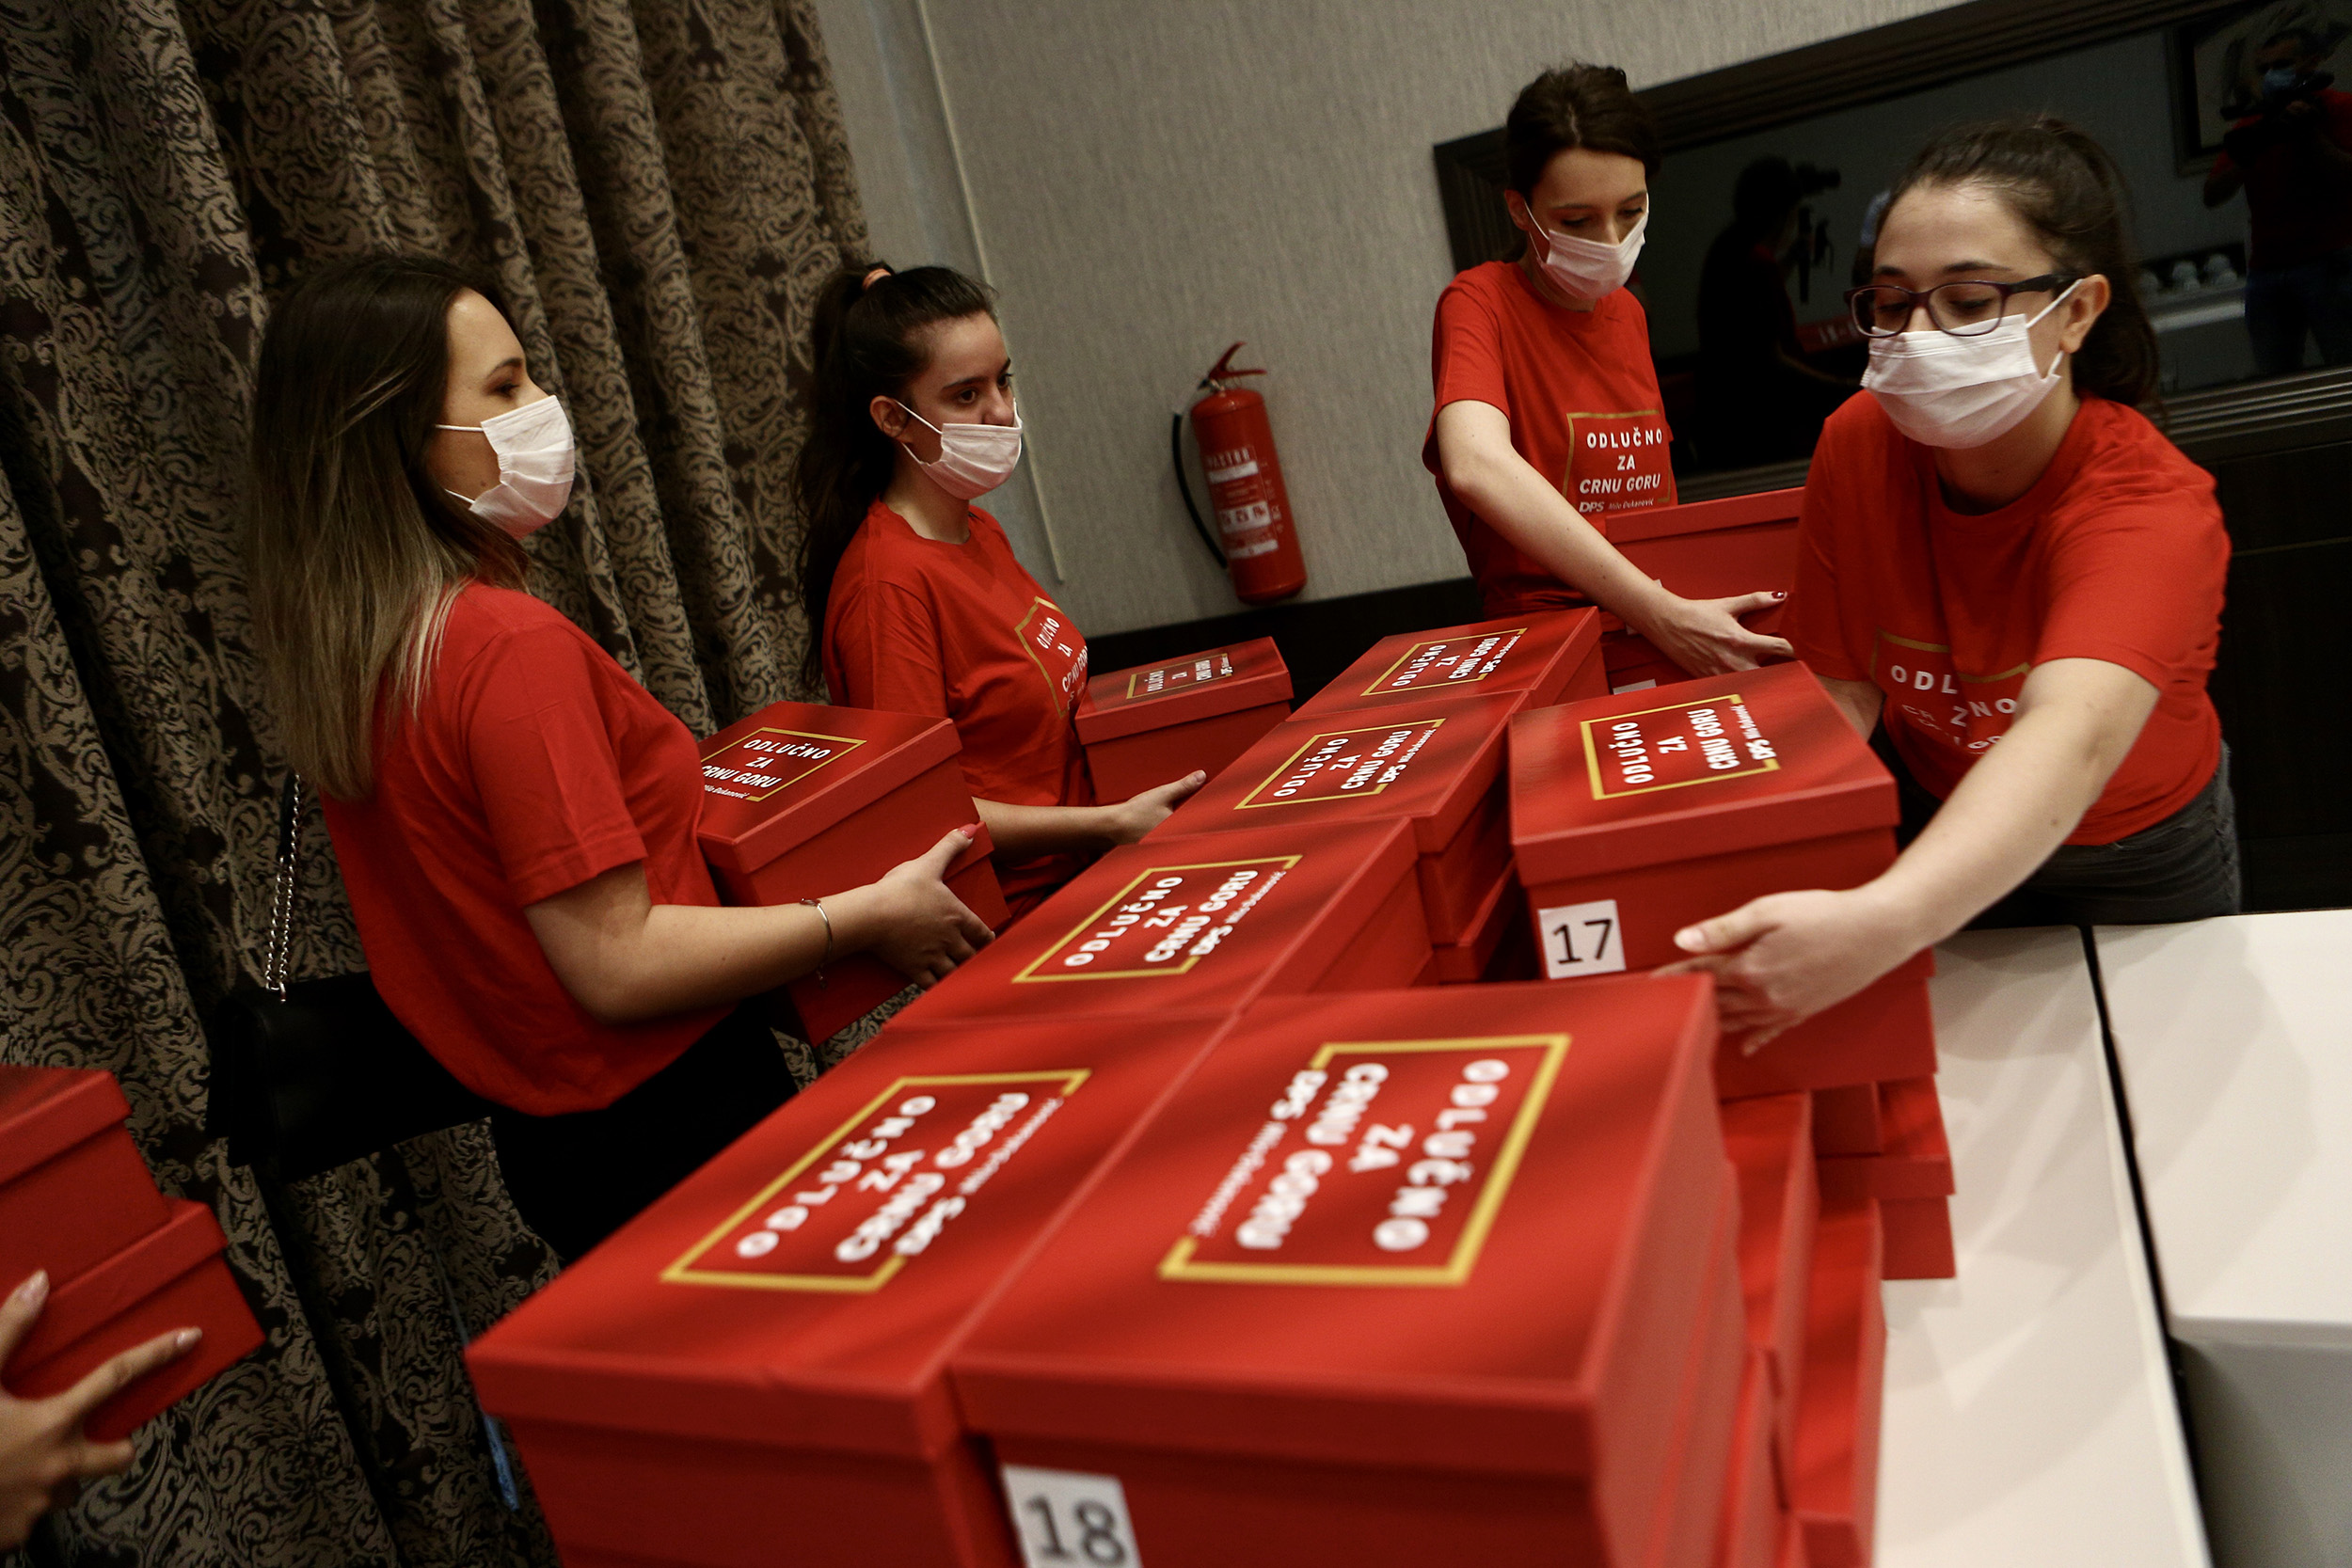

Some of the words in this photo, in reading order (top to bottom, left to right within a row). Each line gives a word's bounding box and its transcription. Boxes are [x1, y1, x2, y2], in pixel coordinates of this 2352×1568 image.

[1586, 426, 1662, 449] ODLUČNO
[1617, 454, 1635, 470] ZA
[1579, 478, 1622, 494] CRNU
[1626, 473, 1661, 492] GORU
[1579, 501, 1605, 513] DPS
[1391, 644, 1447, 687] ODLUČNO
[1435, 655, 1460, 668] ZA
[1448, 657, 1482, 679] CRNU
[1470, 637, 1501, 657] GORU
[1479, 658, 1502, 673] DPS
[1687, 708, 1724, 737] GORU
[743, 738, 832, 759] ODLUČNO
[1341, 759, 1385, 789] CRNU
[1371, 730, 1412, 757] GORU
[1609, 721, 1654, 784] ODLUČNO
[1657, 736, 1689, 753] ZA
[1699, 737, 1740, 770] CRNU
[1745, 739, 1776, 760] DPS
[745, 756, 774, 768] ZA
[1273, 737, 1349, 797] ODLUČNO
[1329, 754, 1361, 771] ZA
[1376, 764, 1406, 784] DPS
[733, 772, 782, 788] GORU
[1064, 876, 1184, 967] ODLUČNO
[1143, 905, 1188, 928] ZA
[1144, 914, 1211, 962] CRNU
[1198, 870, 1258, 912] GORU
[1188, 925, 1232, 957] DPS
[1553, 919, 1613, 964] 17
[1305, 1062, 1389, 1146] CRNU
[1347, 1122, 1415, 1174] ZA
[1373, 1058, 1510, 1252] ODLUČNO
[736, 1095, 936, 1259] ODLUČNO
[834, 1172, 946, 1263] CRNU
[934, 1092, 1030, 1169] GORU
[857, 1148, 925, 1193] ZA
[1235, 1148, 1333, 1251] GORU
[1025, 1495, 1127, 1565] 18
